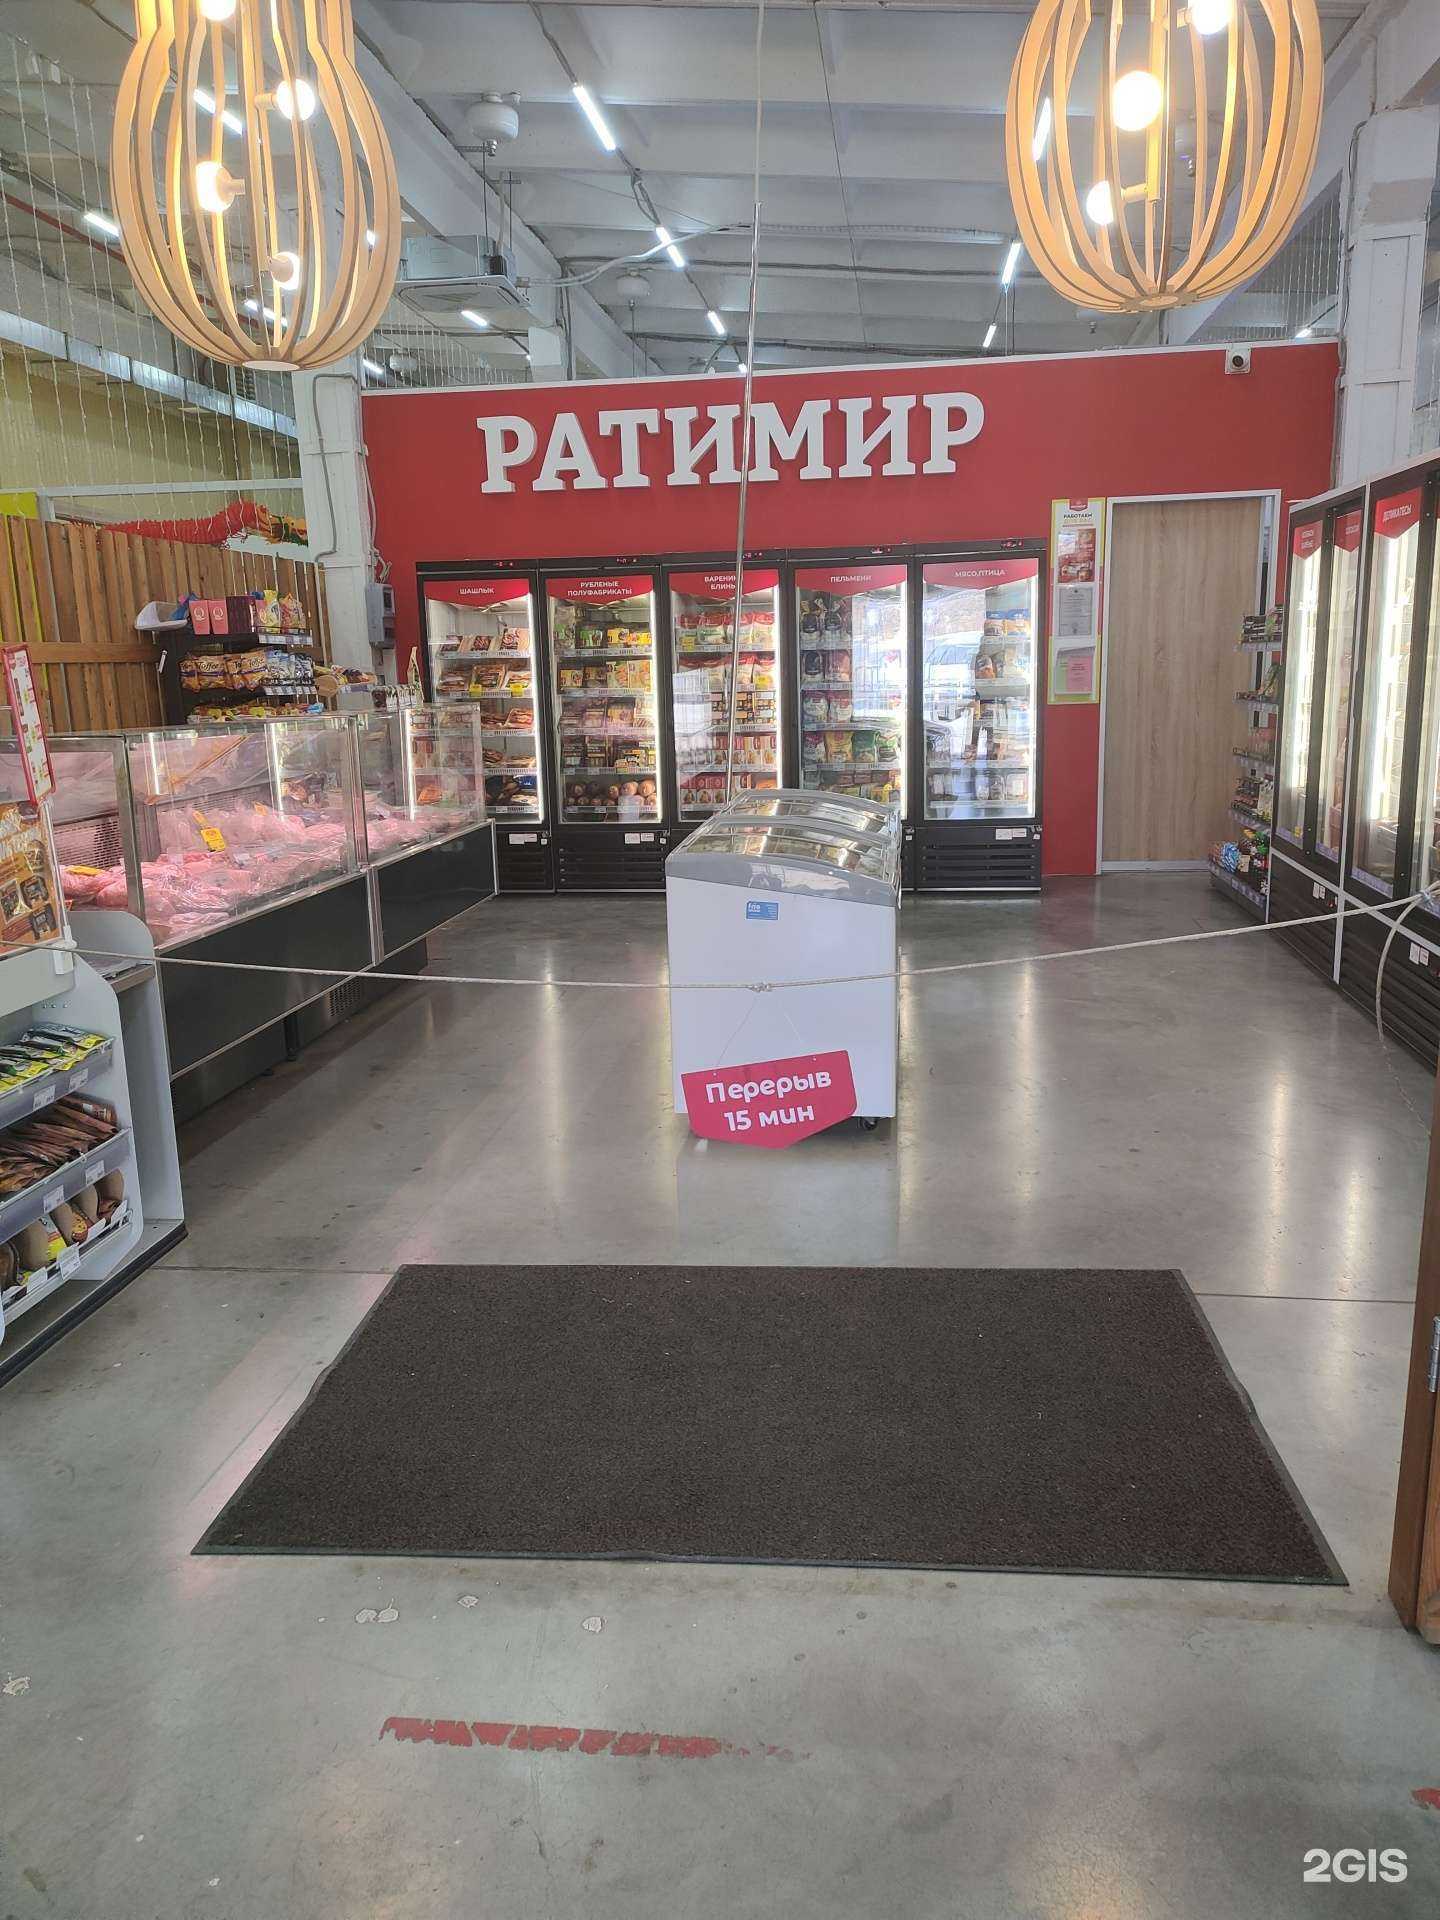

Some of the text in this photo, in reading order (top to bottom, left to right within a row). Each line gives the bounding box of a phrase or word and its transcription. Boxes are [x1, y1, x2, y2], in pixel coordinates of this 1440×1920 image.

[476, 392, 985, 493] РАТИМИР
[830, 574, 872, 583] ПЕЛЬМЕНИ
[580, 580, 620, 588] РУБЛЕНЫЕ
[459, 587, 495, 595] ШАШЛЫК
[567, 588, 633, 596] ПОЛУФАБРИКАТЫ
[705, 1071, 832, 1103] Перерыв
[724, 1105, 815, 1132] 15 мин
